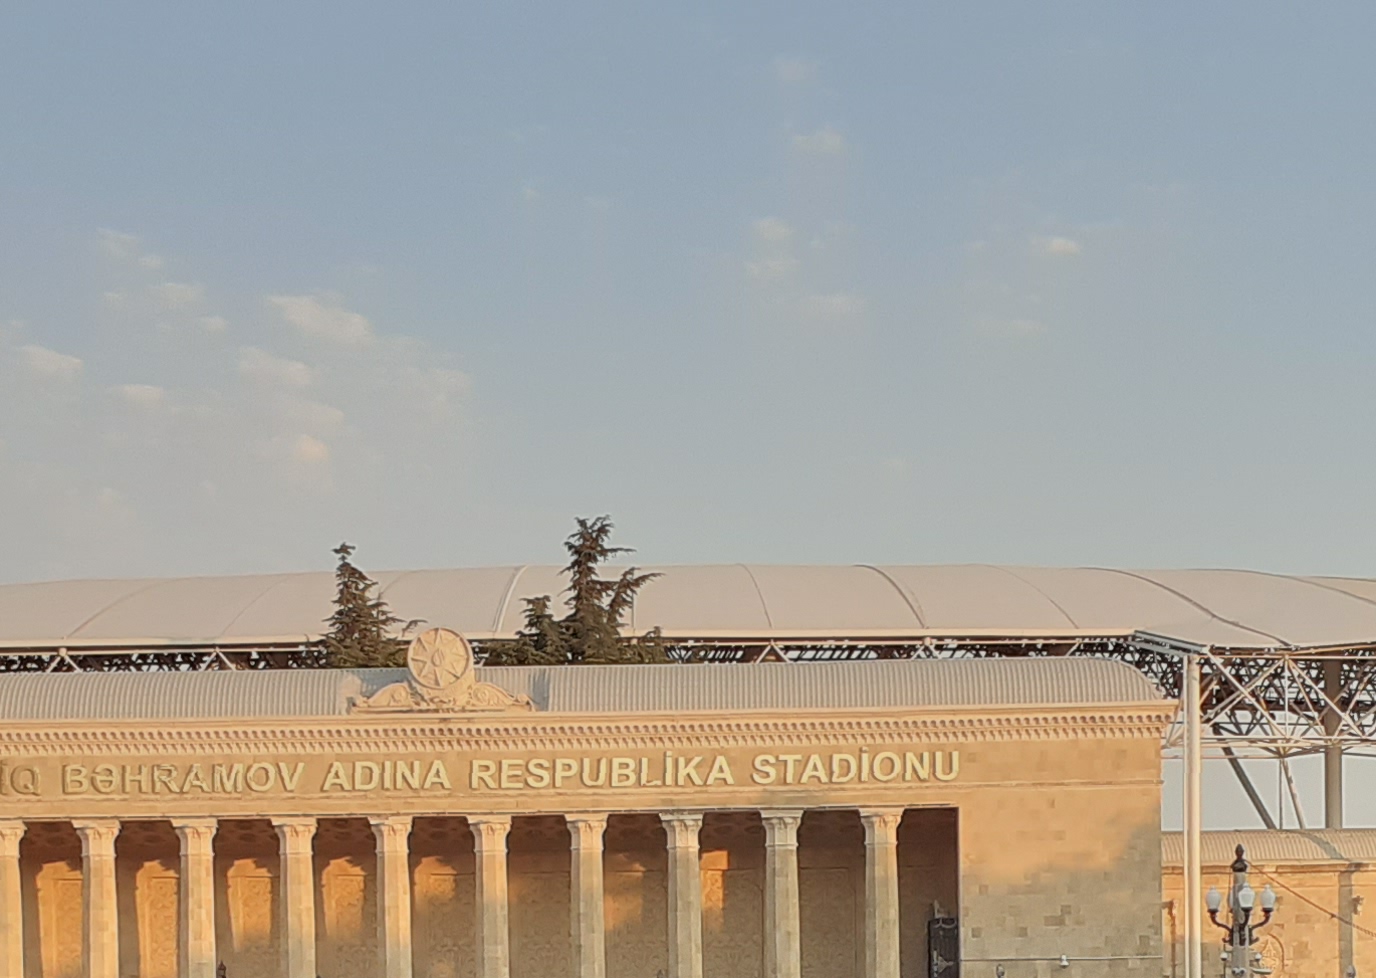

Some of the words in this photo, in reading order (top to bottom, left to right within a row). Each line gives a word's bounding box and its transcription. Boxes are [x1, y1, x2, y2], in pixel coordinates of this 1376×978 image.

[62, 762, 305, 794] BƏHRAMOV
[324, 760, 452, 791] ADINA
[470, 751, 735, 790] RESPUBLİKA
[752, 746, 959, 784] STADİONU
